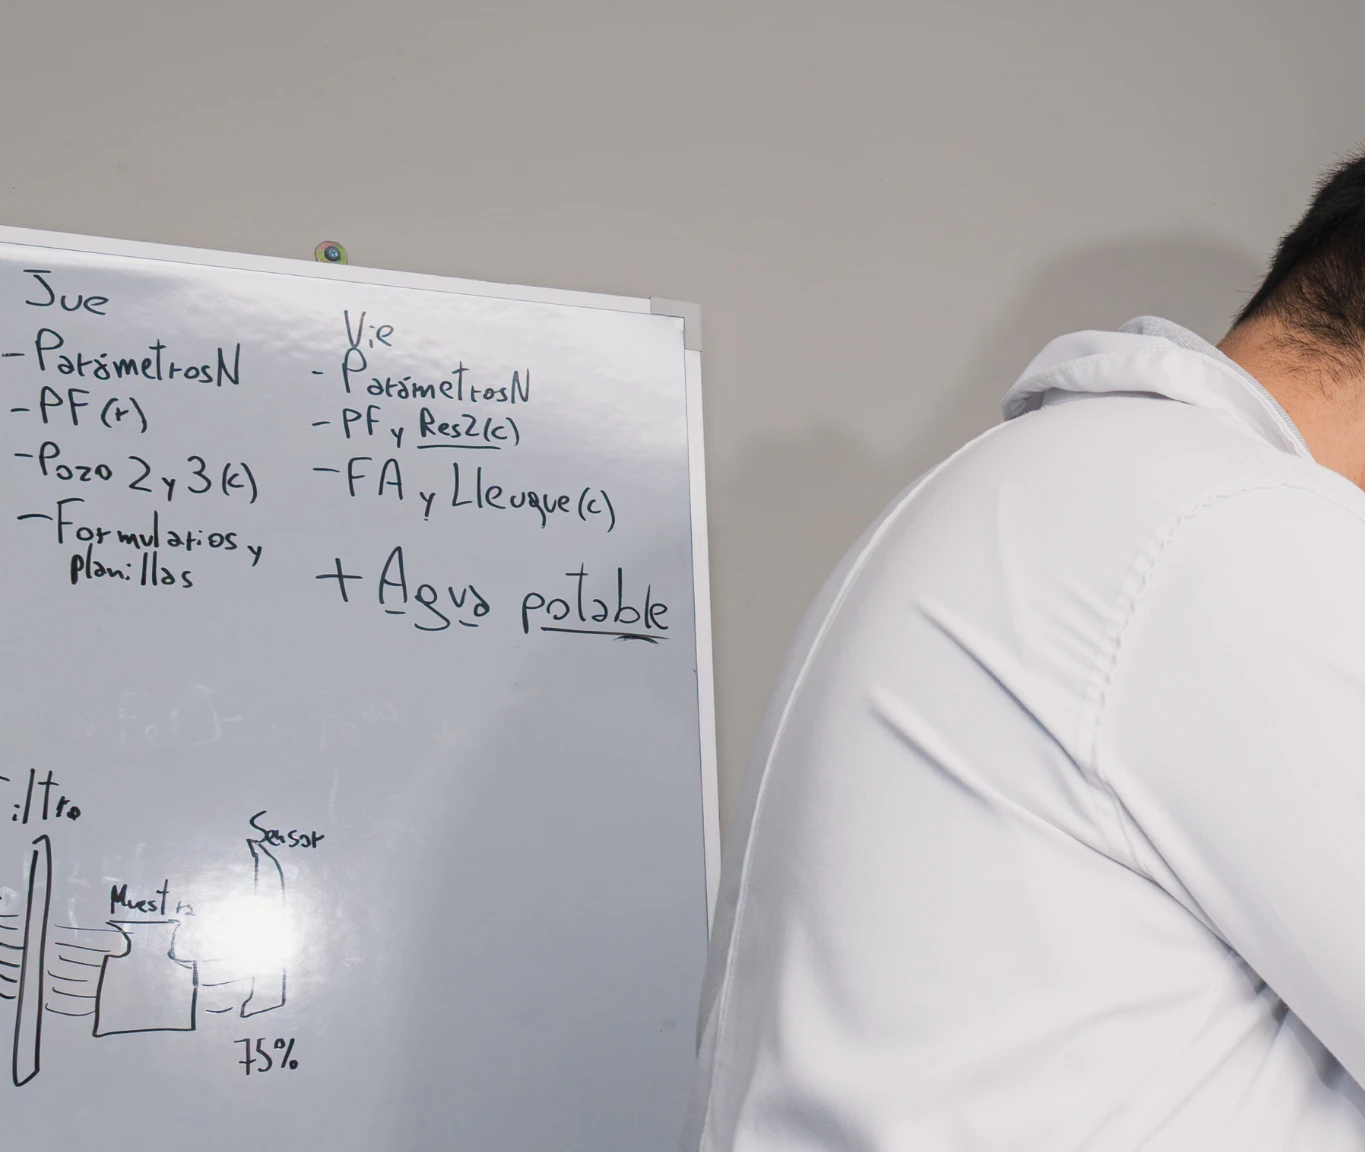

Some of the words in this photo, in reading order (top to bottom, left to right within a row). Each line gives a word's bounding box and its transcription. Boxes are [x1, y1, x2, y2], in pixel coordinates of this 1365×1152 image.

[22, 268, 110, 316] Jue
[343, 309, 395, 349] Vie
[390, 426, 405, 449] y
[127, 455, 153, 493] 2
[160, 476, 177, 503] y
[418, 491, 437, 522] y
[69, 542, 194, 589] planillas
[246, 544, 263, 568] y
[378, 544, 491, 632] Agua
[521, 562, 669, 636] potable
[0, 767, 82, 825] iltro
[233, 1037, 299, 1076] 75%
